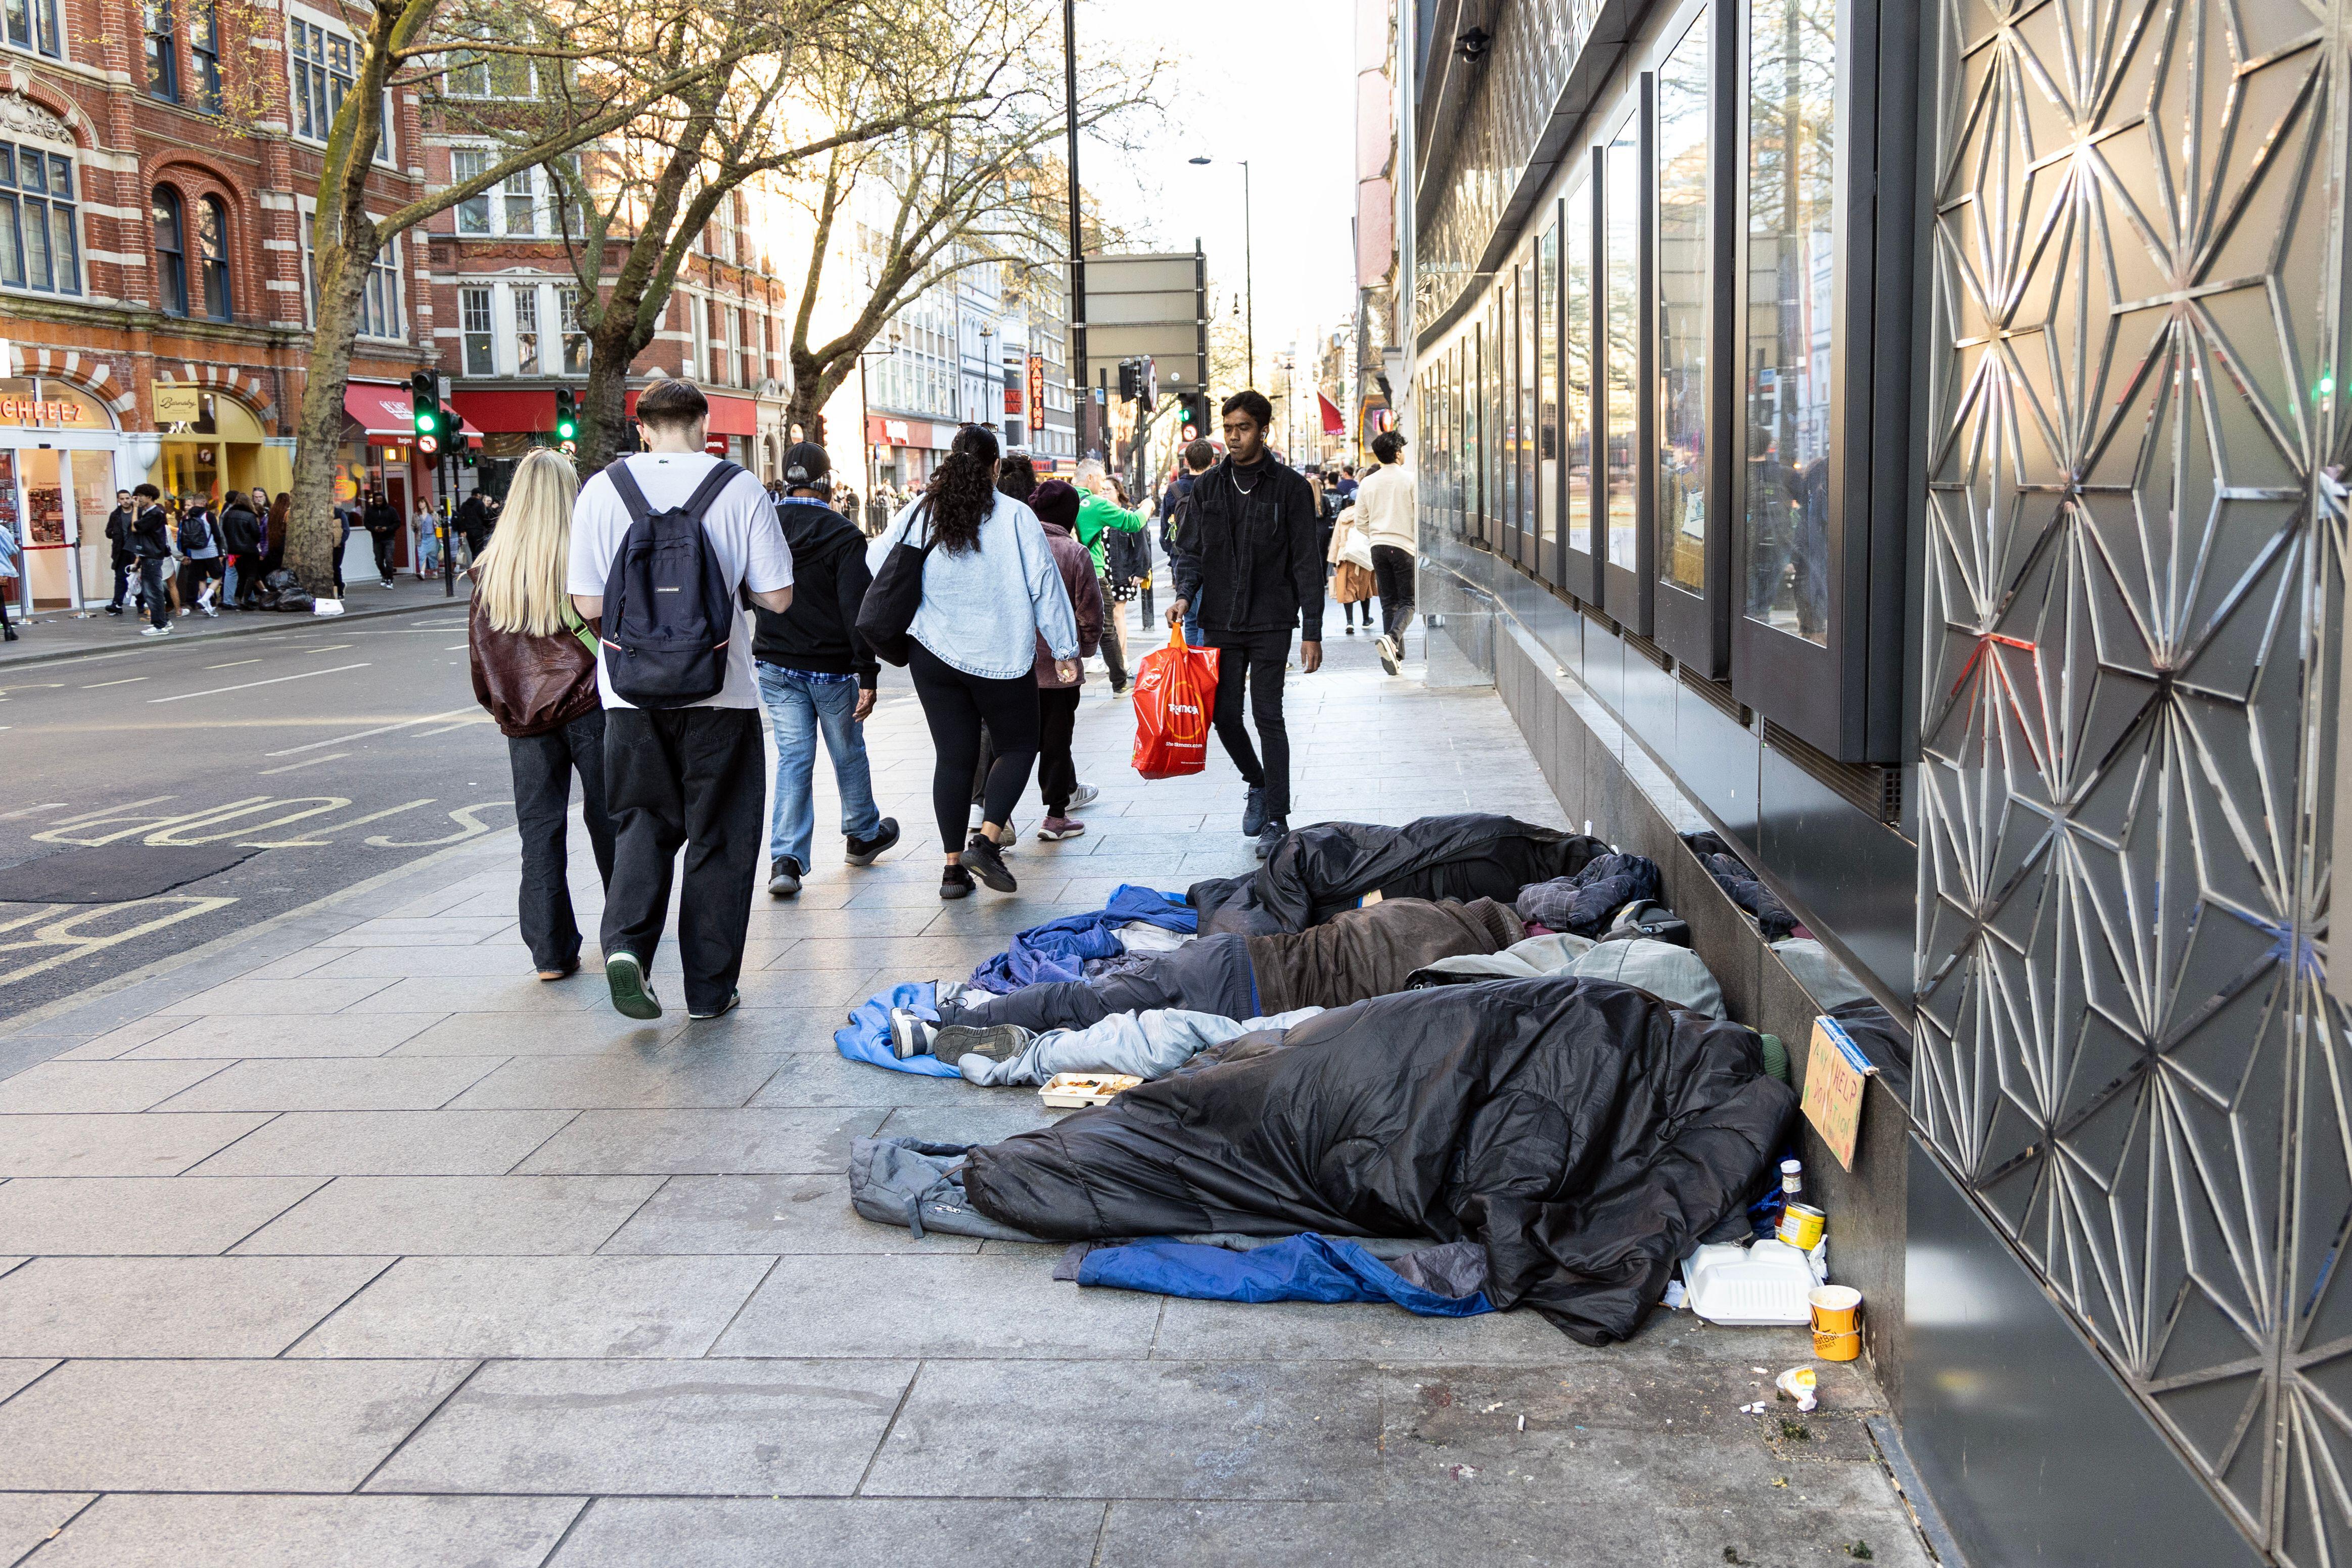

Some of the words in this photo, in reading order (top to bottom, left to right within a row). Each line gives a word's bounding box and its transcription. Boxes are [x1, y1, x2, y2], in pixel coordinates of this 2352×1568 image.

[160, 396, 196, 408] Barnaby
[1031, 357, 1043, 429] HAWKINS
[1, 400, 84, 421] CHEEEZ
[1833, 1063, 1857, 1106] HELP
